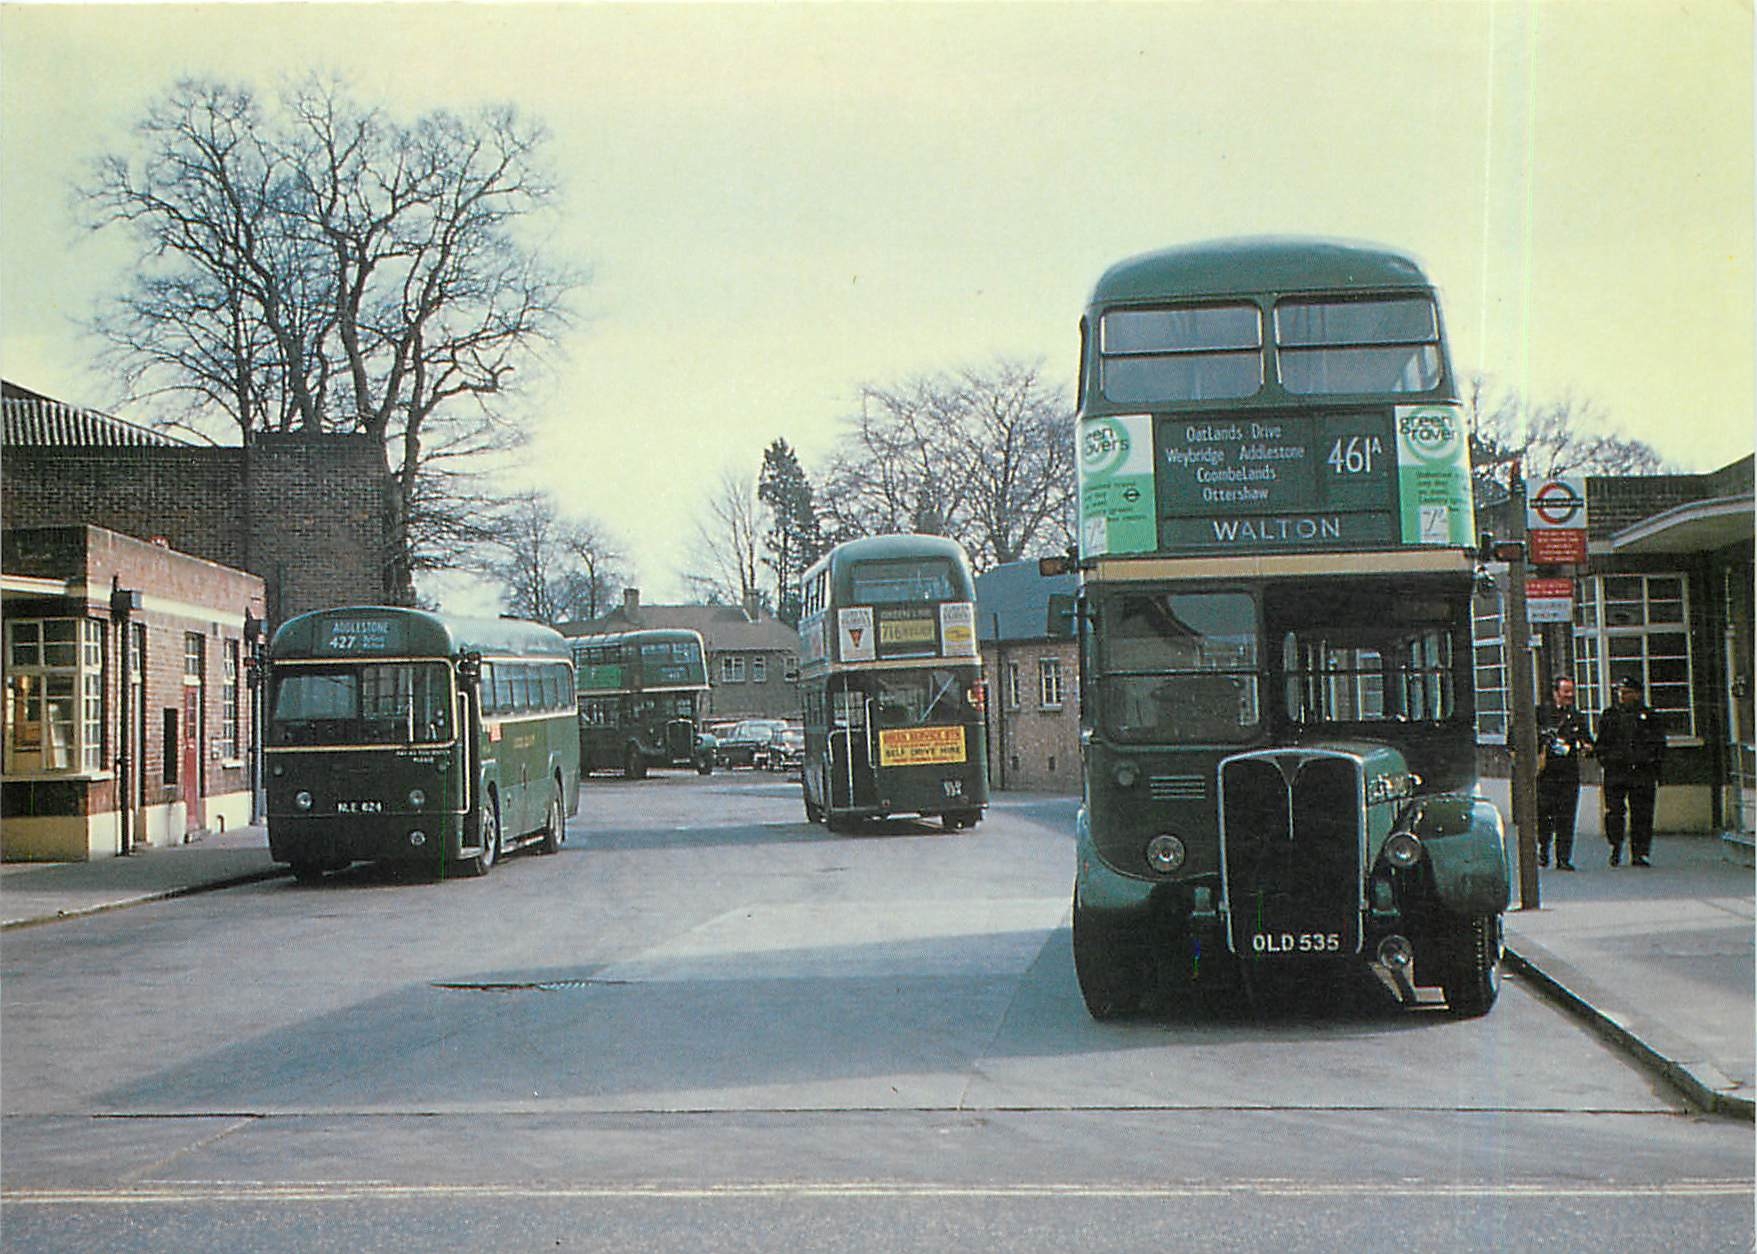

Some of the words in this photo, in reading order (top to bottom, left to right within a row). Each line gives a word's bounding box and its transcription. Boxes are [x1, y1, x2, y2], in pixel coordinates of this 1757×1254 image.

[1185, 424, 1243, 442] Oatlands
[1251, 422, 1282, 440] Drive
[1164, 446, 1225, 467] Weybridge
[1239, 443, 1305, 461] Addlestone
[1196, 463, 1277, 483] Coombelands
[1202, 485, 1269, 502] Ottershaw
[1213, 517, 1341, 542] WALTON
[329, 635, 356, 649] 427
[881, 623, 901, 641] 716
[1252, 933, 1295, 953] OLD
[1299, 932, 1341, 952] 535
